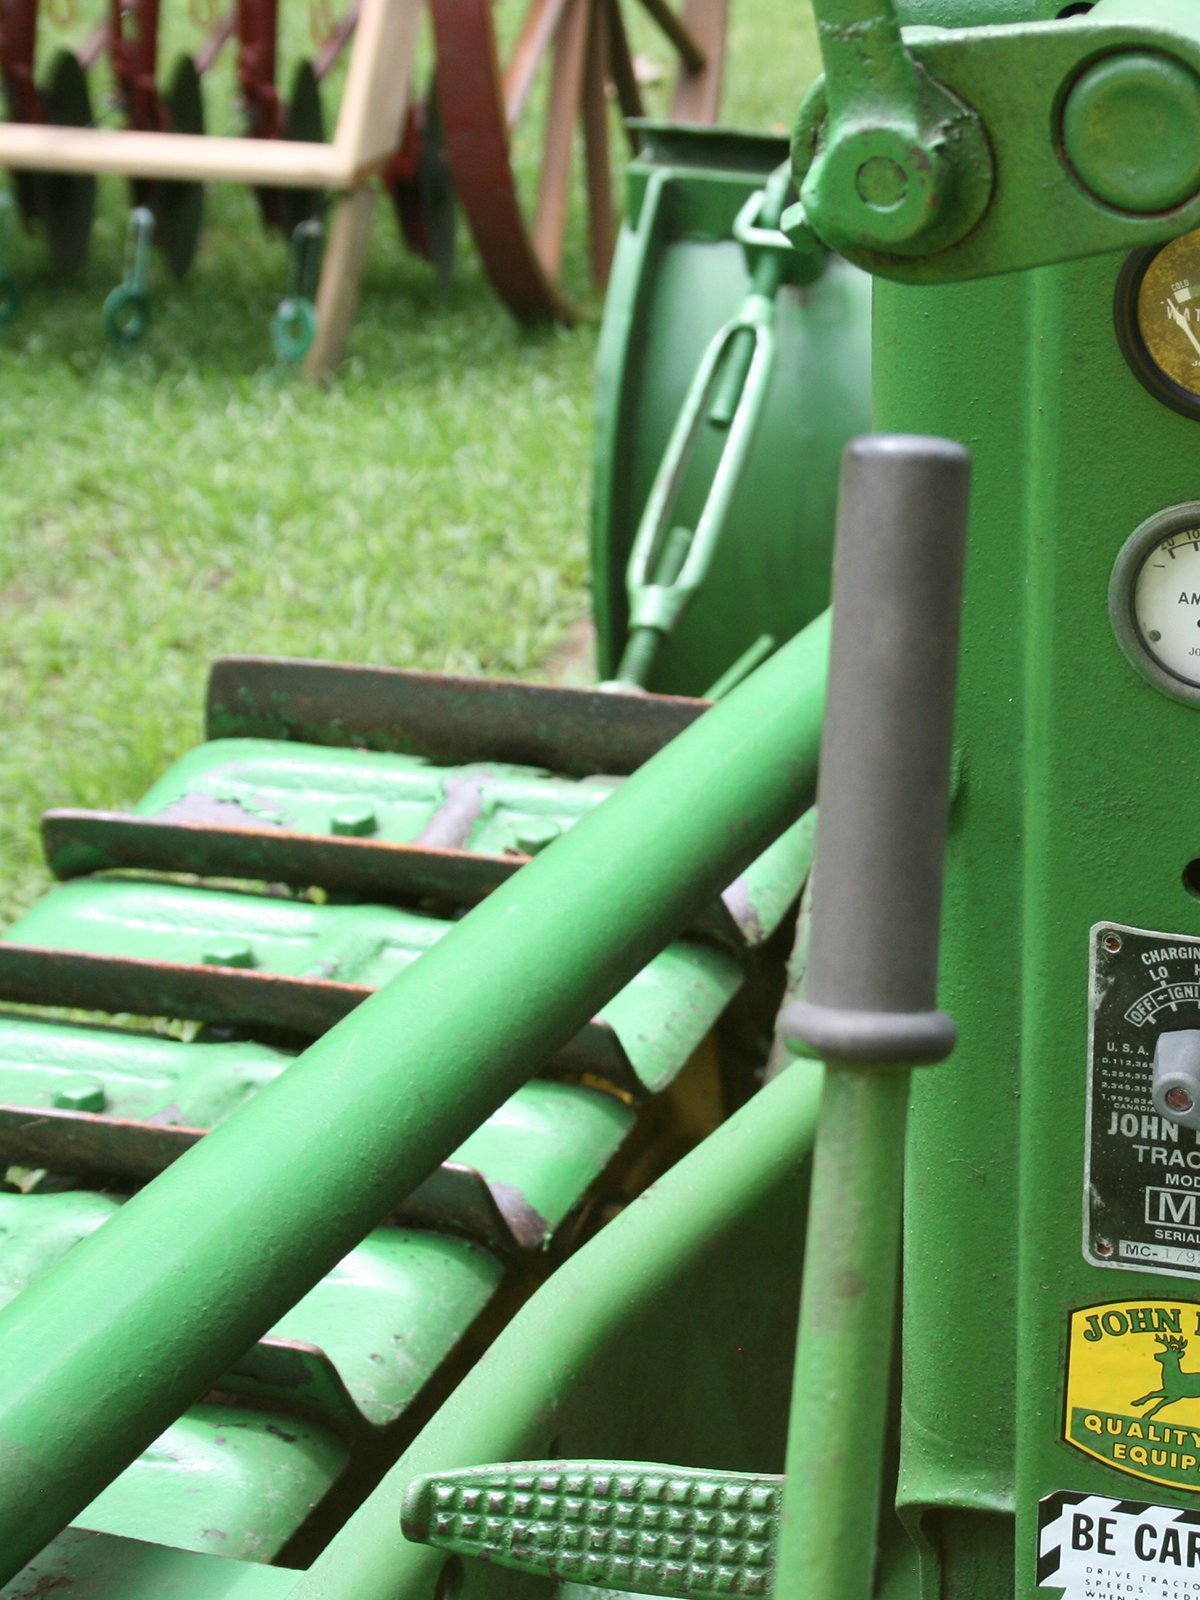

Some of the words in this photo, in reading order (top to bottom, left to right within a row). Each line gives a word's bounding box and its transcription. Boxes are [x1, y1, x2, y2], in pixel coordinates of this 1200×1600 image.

[1149, 965, 1168, 983] LO
[1129, 998, 1154, 1023] OFF
[1113, 1102, 1157, 1113] CANADIA
[1107, 1111, 1179, 1143] JOHN
[1083, 1308, 1182, 1342] JOHN
[1071, 1512, 1118, 1556] BE
[1085, 1566, 1131, 1580] DRIVE
